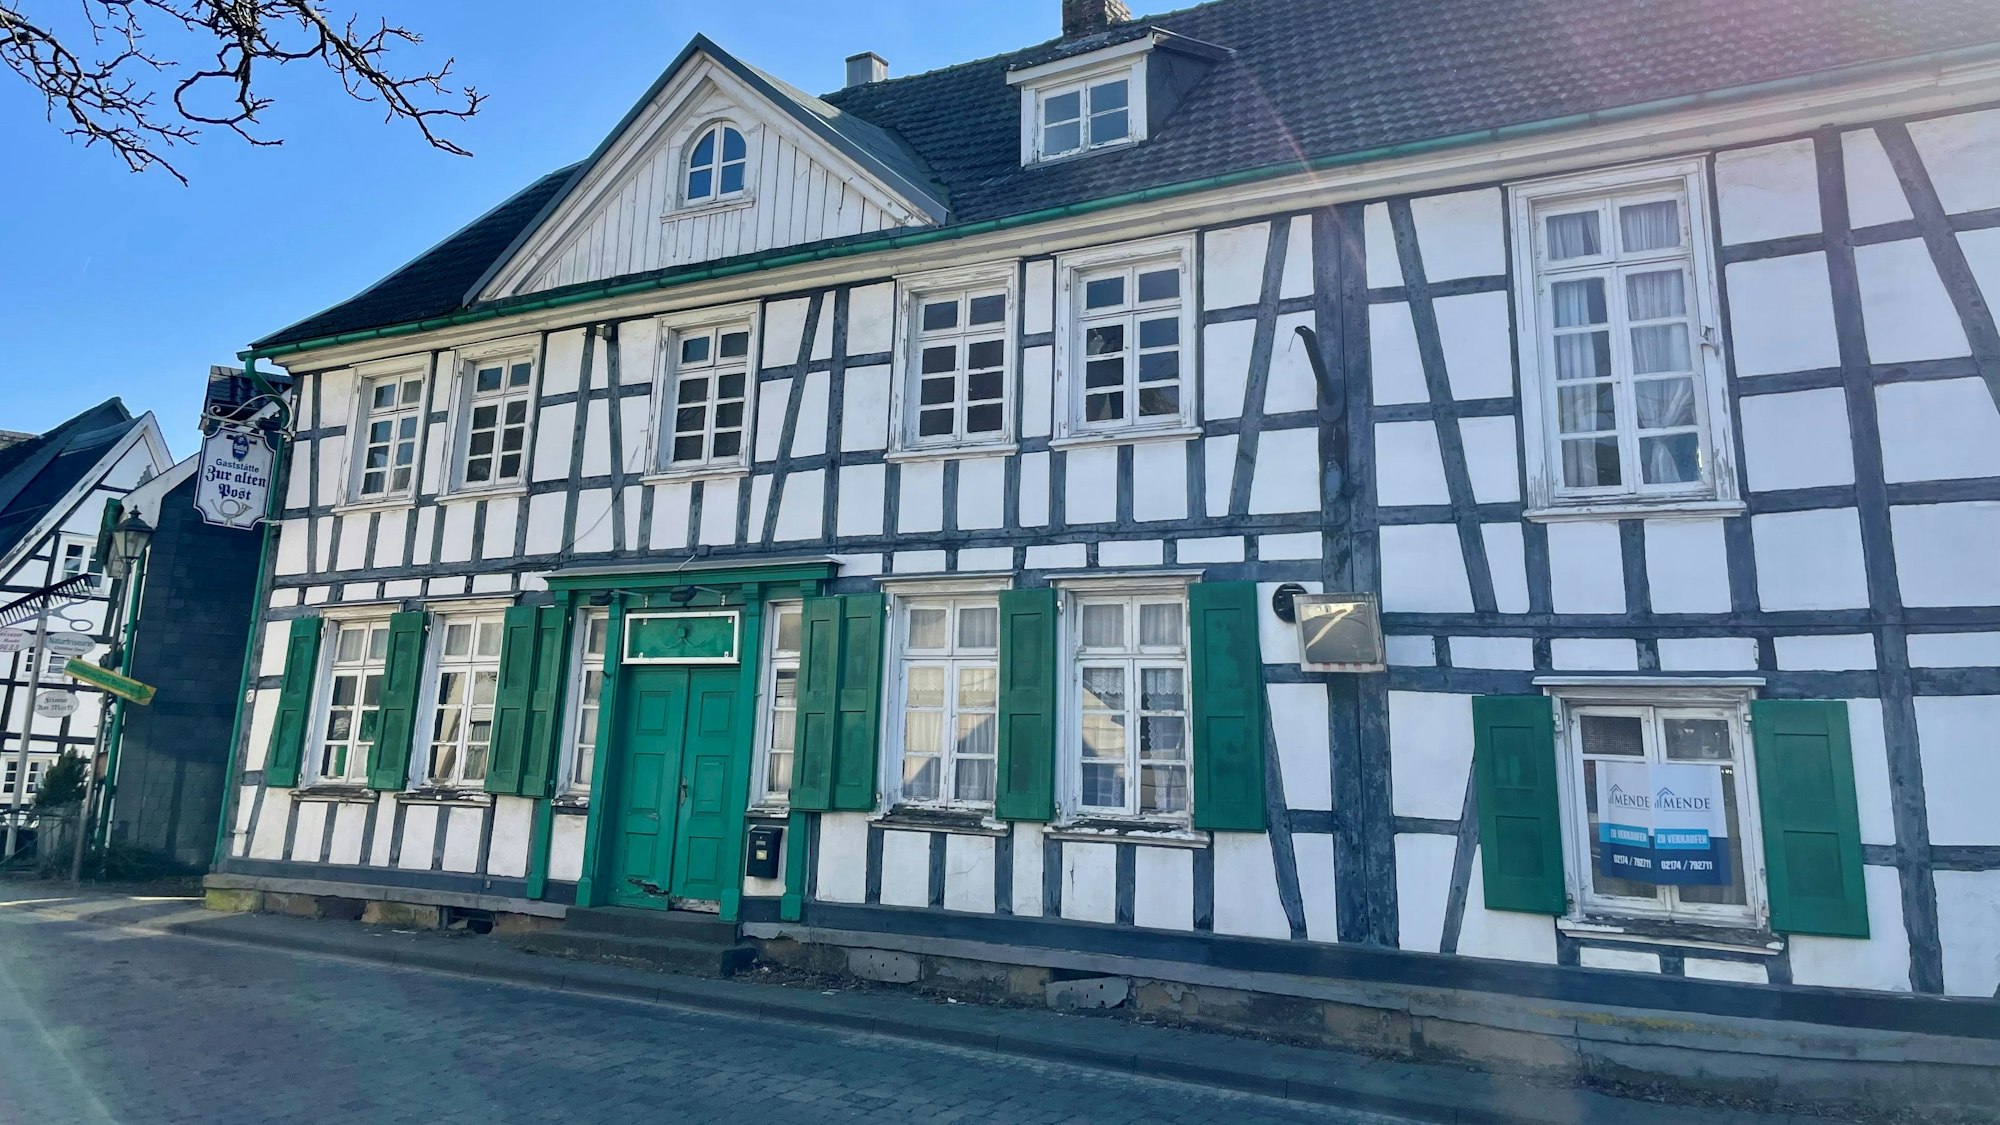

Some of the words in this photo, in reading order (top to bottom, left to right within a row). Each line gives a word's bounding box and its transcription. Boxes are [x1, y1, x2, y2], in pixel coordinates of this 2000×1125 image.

[216, 458, 260, 474] Gaststätte
[205, 465, 232, 482] Zur
[234, 472, 266, 488] alten
[218, 484, 252, 500] Post
[1614, 794, 1650, 808] MENDE
[1664, 798, 1711, 810] MENDE
[1618, 830, 1647, 842] VERKAUFEN
[1656, 834, 1666, 844] ZU
[1666, 834, 1708, 844] VERKAUFEN
[1660, 860, 1682, 870] 02174
